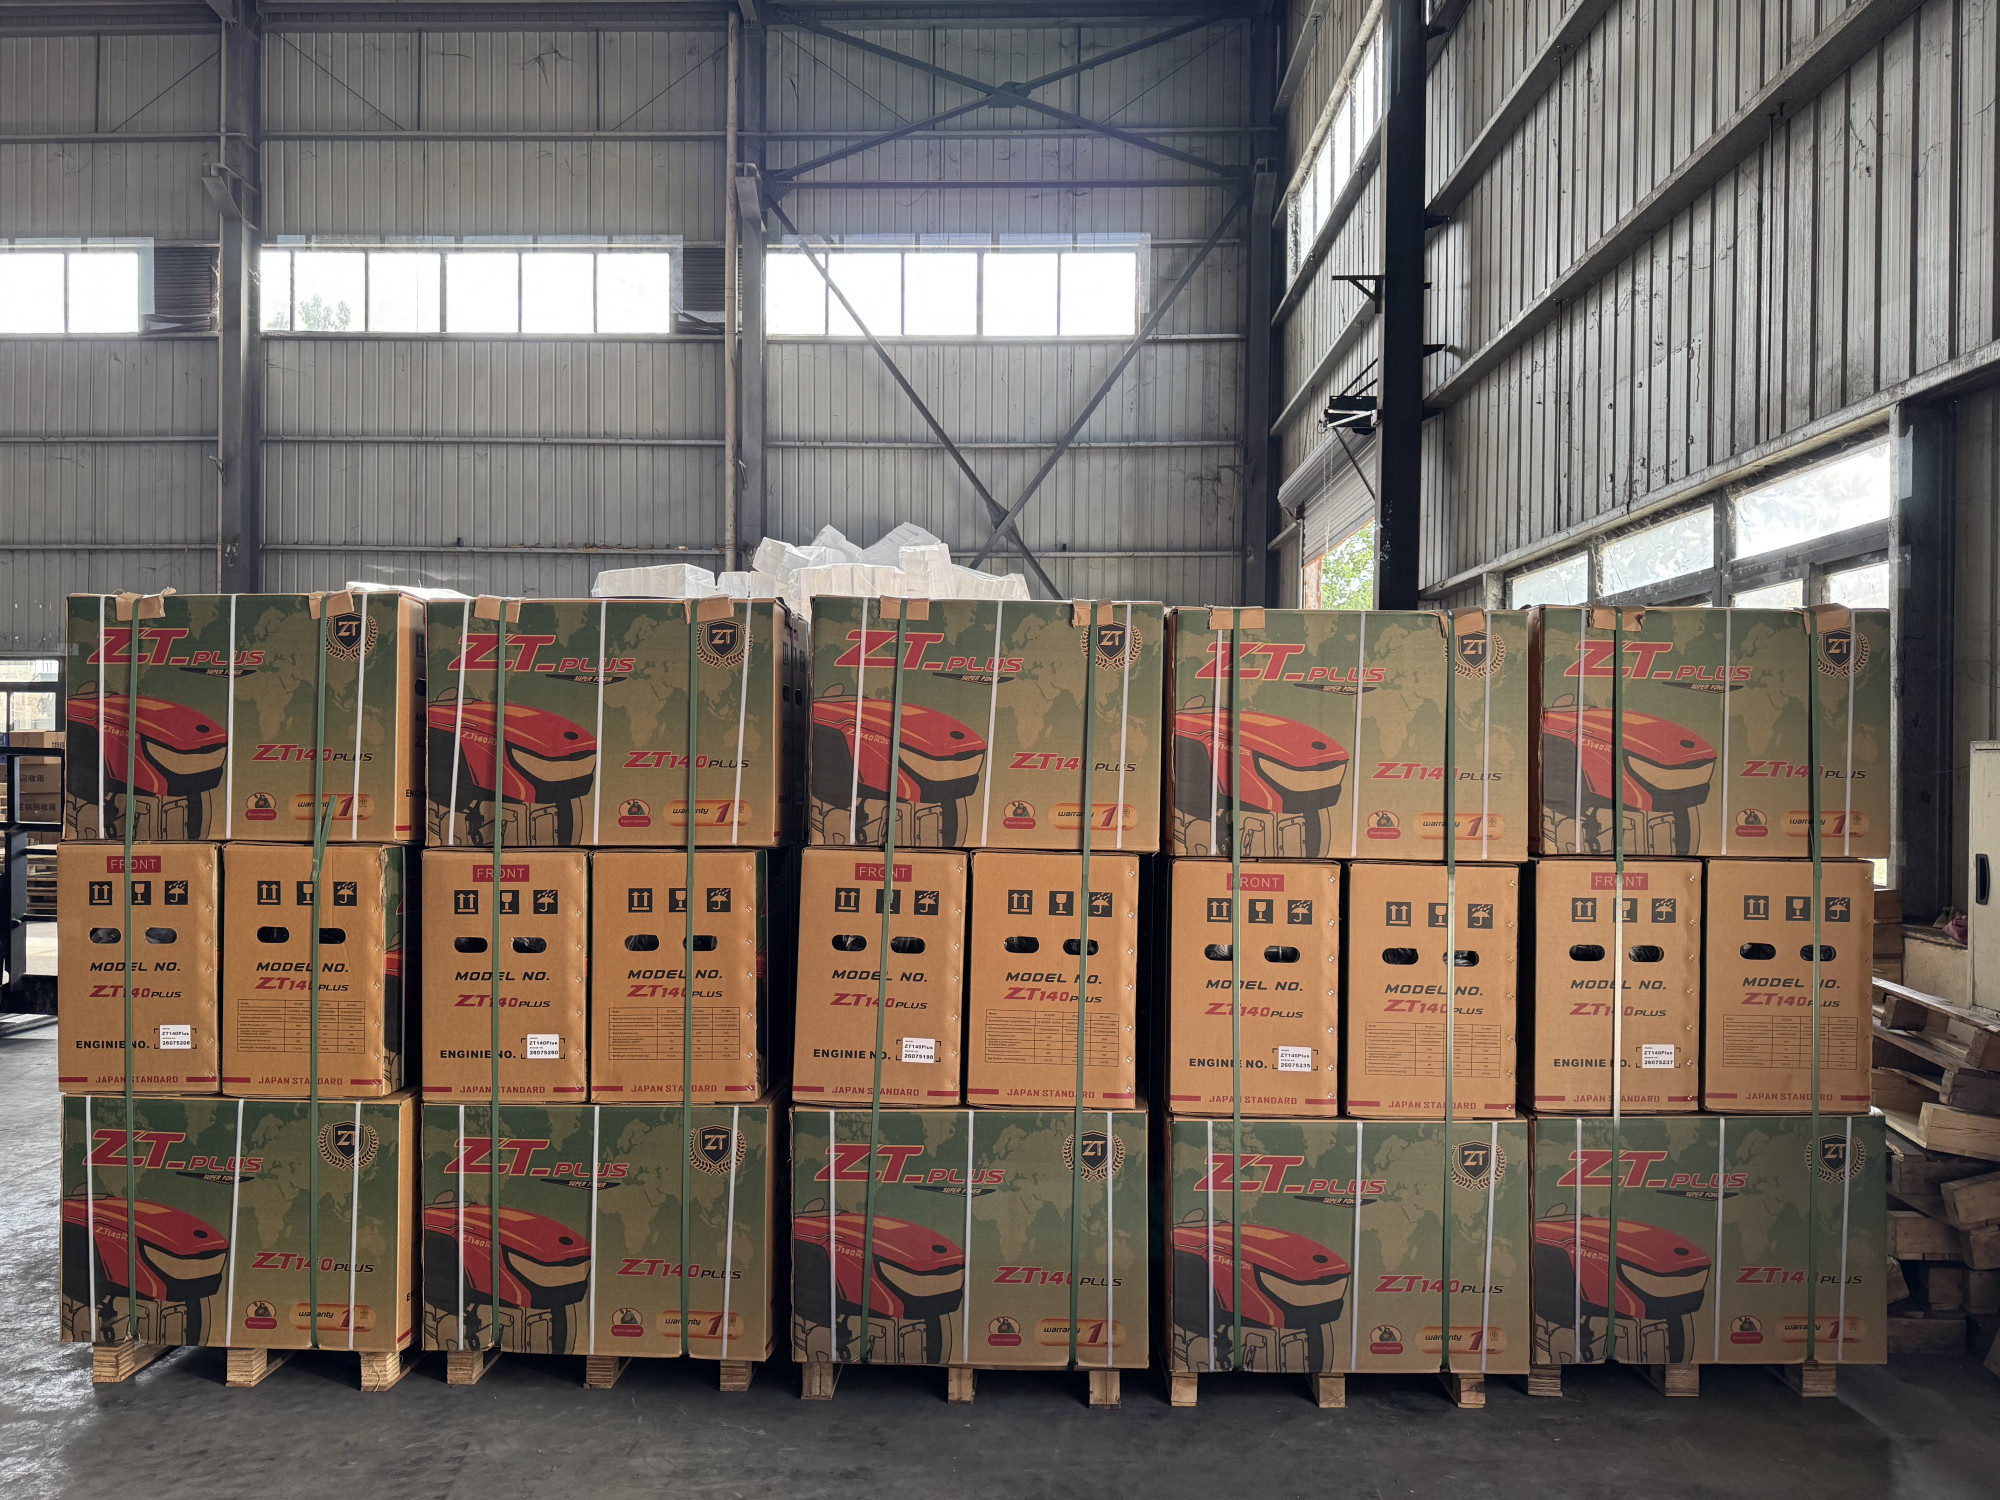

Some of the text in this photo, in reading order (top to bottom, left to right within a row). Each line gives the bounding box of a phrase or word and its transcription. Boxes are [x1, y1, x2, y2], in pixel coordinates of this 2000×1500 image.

[337, 620, 361, 636] ZT
[711, 629, 735, 644] ZT
[1099, 630, 1124, 646] ZT
[1463, 639, 1487, 655] ZT
[1828, 638, 1851, 654] ZT
[1230, 875, 1279, 888] RONT
[1595, 876, 1644, 887] FRNT
[154, 962, 181, 971] NO.
[256, 961, 348, 973] MODEL NO.
[522, 971, 550, 981] NO.
[627, 969, 722, 979] MODEL NO.
[900, 972, 928, 983] NO.
[1005, 971, 1066, 983] MODEL
[1275, 981, 1303, 992] NO.
[1638, 980, 1667, 990] NO.
[1742, 977, 1840, 989] MODEL O.
[89, 984, 183, 998] ZT40PLUS
[1384, 983, 1483, 996] MODEL NO.
[1003, 987, 1102, 1004] ZT140PUS
[1569, 1002, 1667, 1017] ZT10PLUS
[76, 1040, 125, 1049] ENGINIE
[440, 1050, 491, 1059] ENGINIE
[813, 1049, 866, 1059] ENGINIE
[1189, 1058, 1267, 1069] ENGINI NO.
[1554, 1059, 1606, 1068] ENGINIE
[95, 1076, 125, 1084] JAPAN
[258, 1076, 342, 1086] JAPAN STADARD
[459, 1086, 545, 1094] JAPAN TANDARD
[631, 1085, 717, 1093] JAPAN STADARD
[831, 1086, 919, 1097] JAPAN SANDARD
[1006, 1088, 1094, 1100] JAPAN STANDRD
[1208, 1095, 1297, 1106] JAPA STANDARD
[1572, 1095, 1660, 1103] JAPAN SANDARD
[1744, 1092, 1832, 1102] JAPAN STANDRD
[1387, 1100, 1420, 1109] JAPAN
[337, 1130, 360, 1146] ZT
[704, 1135, 728, 1150] ZT
[1082, 1140, 1106, 1156] ZT
[1823, 1143, 1848, 1159] ZT
[1463, 1150, 1488, 1166] ZT
[298, 1311, 334, 1319] waanty
